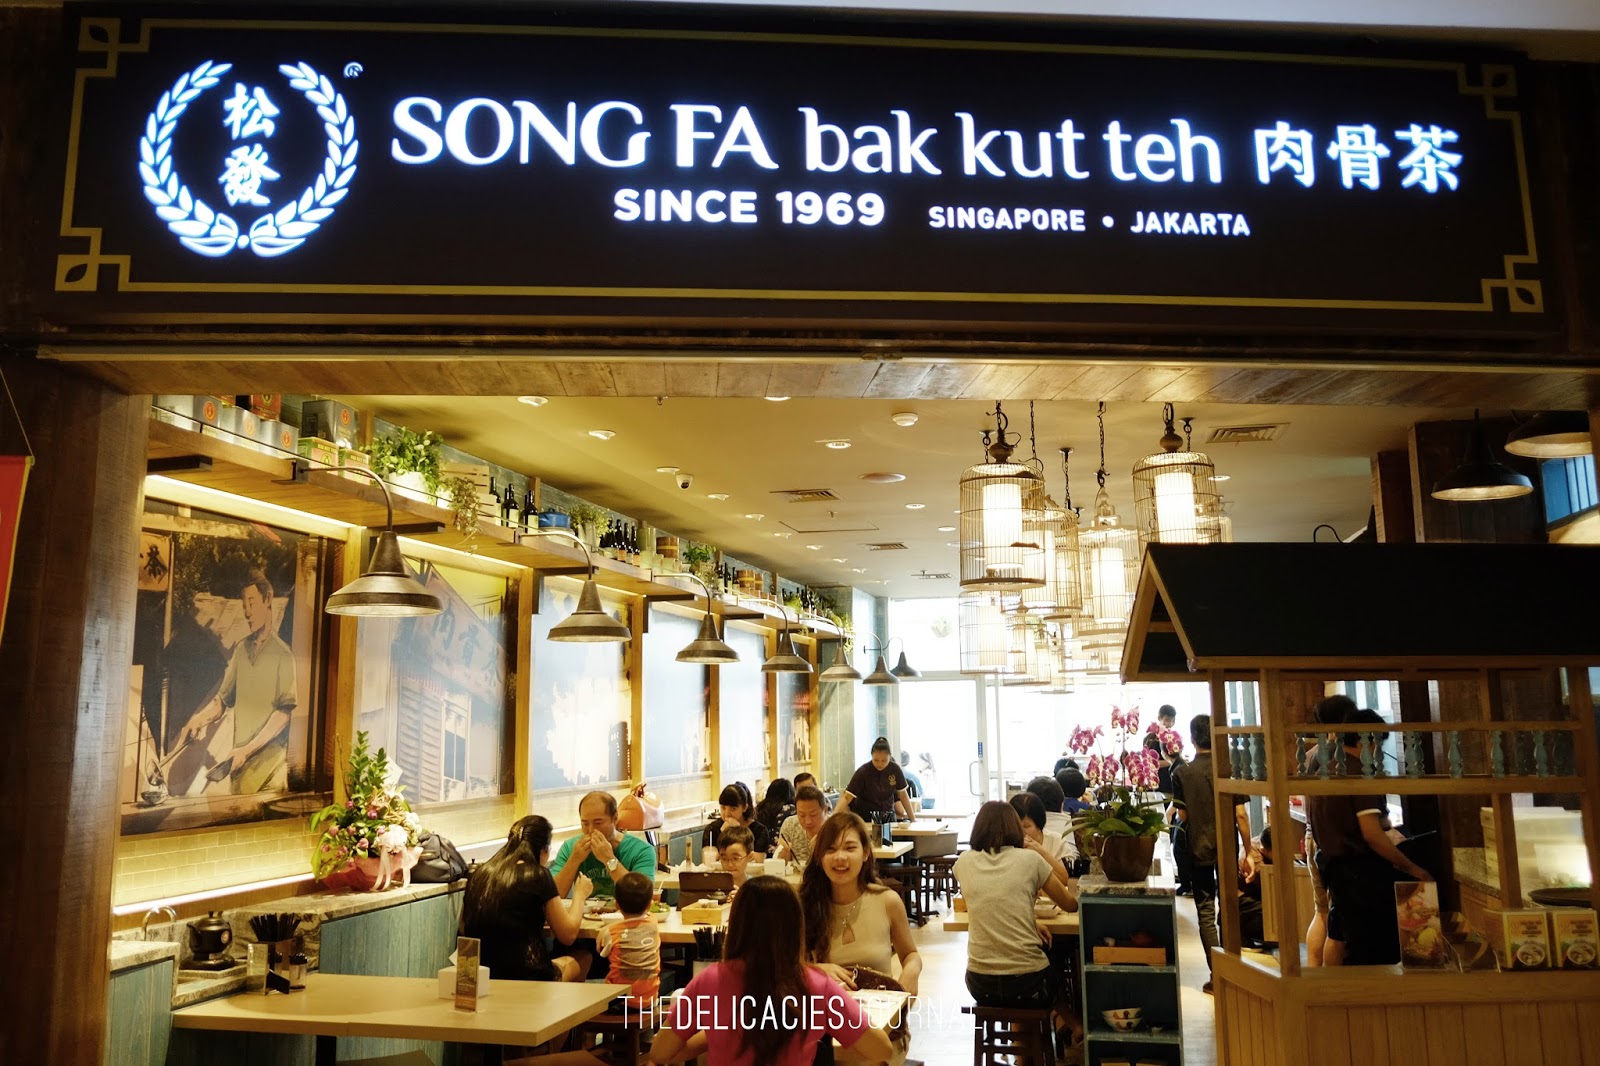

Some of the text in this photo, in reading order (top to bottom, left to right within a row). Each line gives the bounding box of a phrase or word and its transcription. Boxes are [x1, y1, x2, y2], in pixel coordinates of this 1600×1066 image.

[221, 81, 282, 207] 松發
[390, 95, 1225, 185] SONG FA bak kut teh
[1251, 119, 1464, 194] 肉骨茶
[613, 187, 886, 227] SINCE 1969
[928, 205, 1251, 237] SINGAPORE JAKARTA
